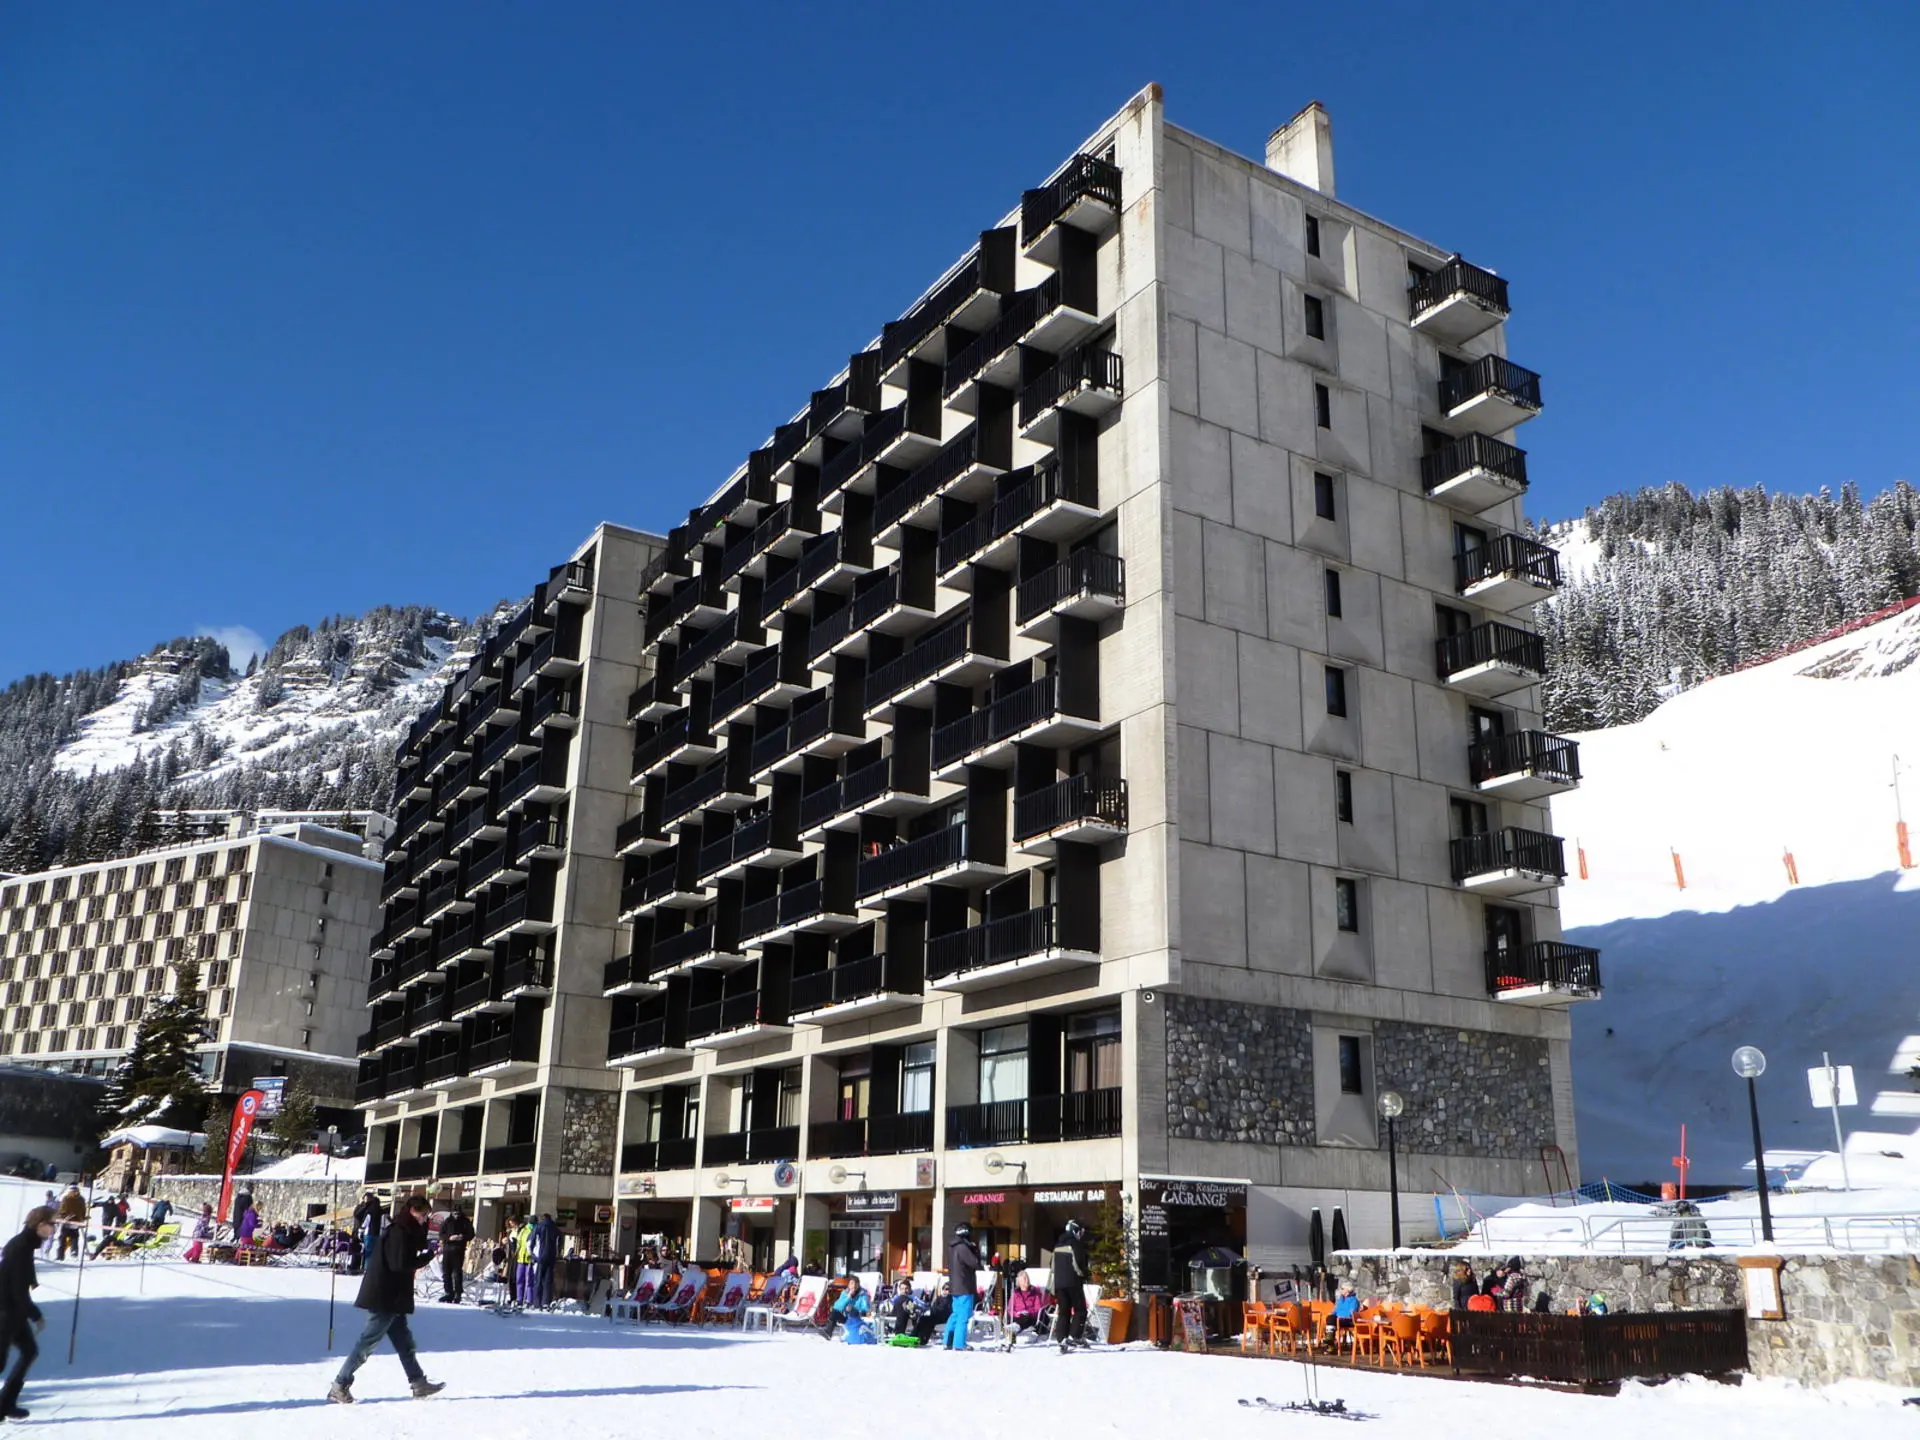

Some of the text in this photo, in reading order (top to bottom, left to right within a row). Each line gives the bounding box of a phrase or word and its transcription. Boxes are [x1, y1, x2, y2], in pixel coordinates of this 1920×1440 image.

[1140, 1180, 1159, 1191] Bar
[1196, 1183, 1246, 1194] Restaurant
[963, 1193, 1005, 1204] LAGRANGE
[1033, 1189, 1106, 1203] RESTAURANT BAR
[1160, 1190, 1228, 1207] LAGRANGE
